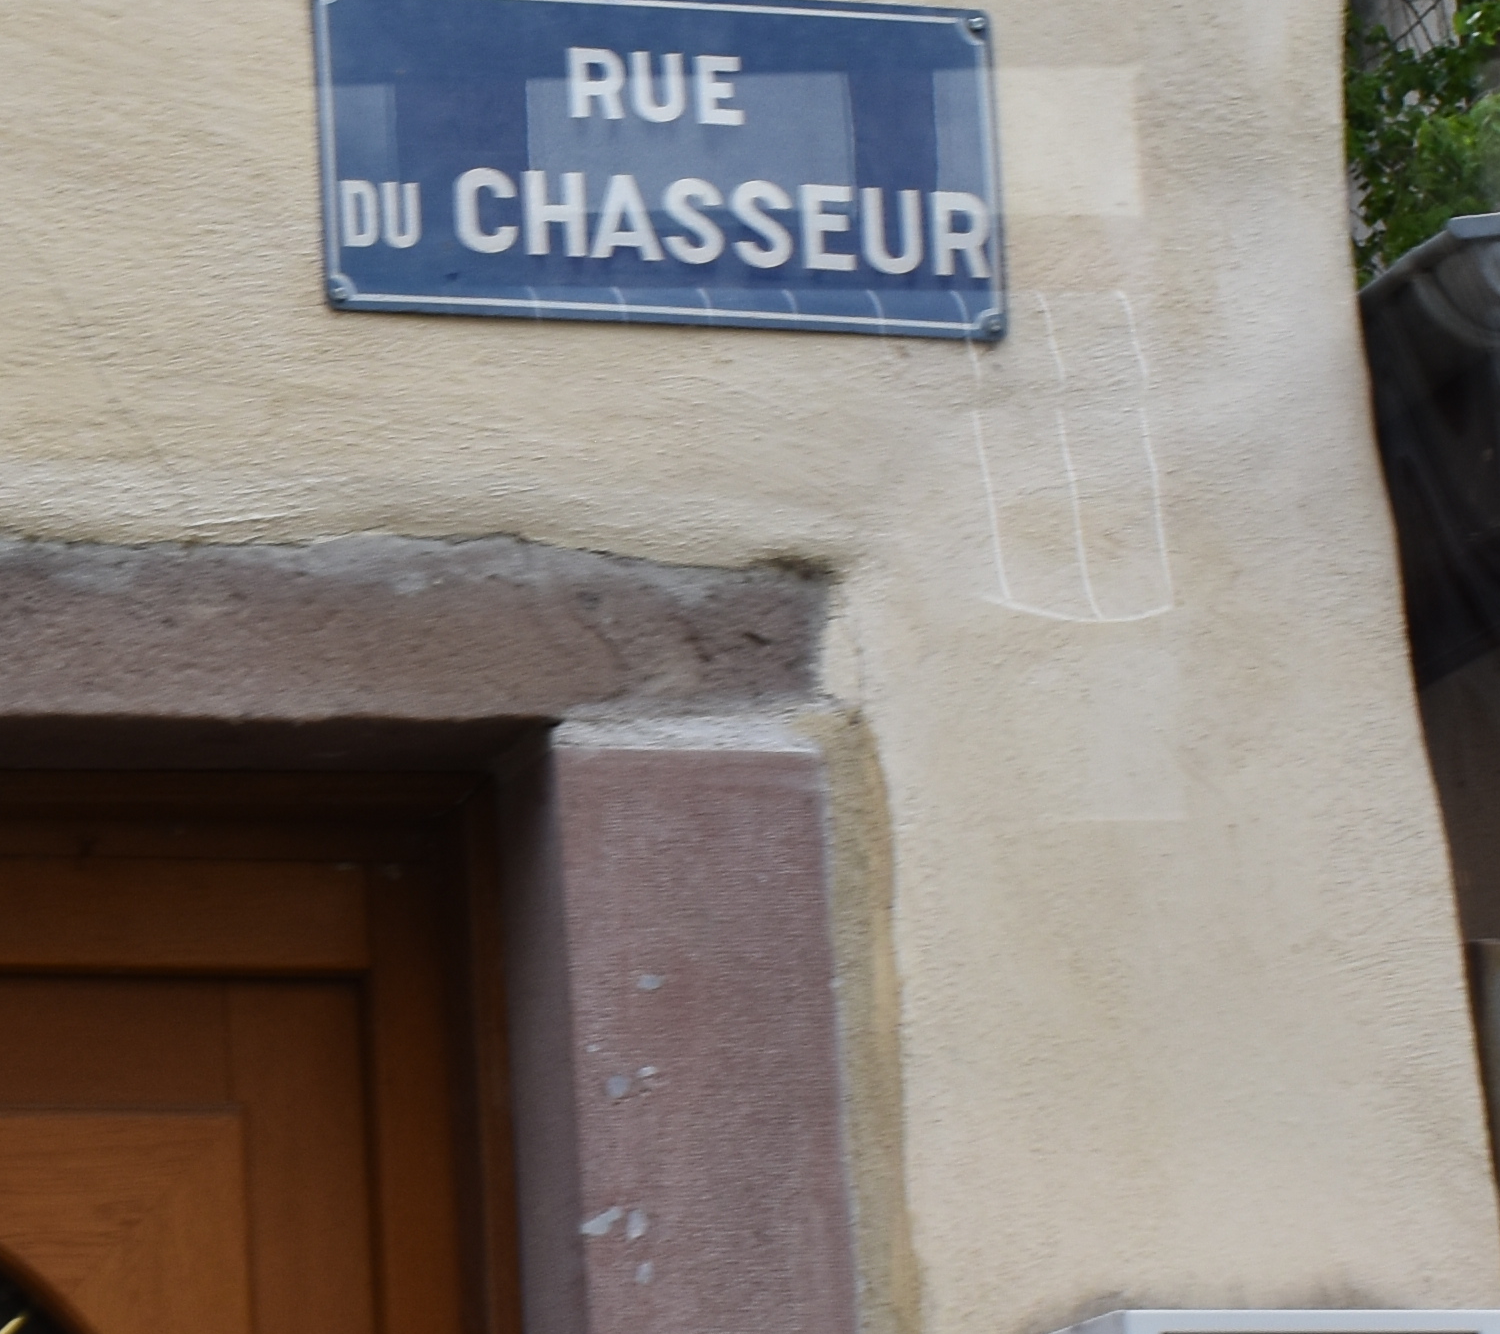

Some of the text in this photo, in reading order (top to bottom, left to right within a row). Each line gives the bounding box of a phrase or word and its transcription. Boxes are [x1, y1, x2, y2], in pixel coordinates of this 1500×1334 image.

[565, 46, 746, 127] RUE
[339, 167, 992, 279] DU CHASSEUR
